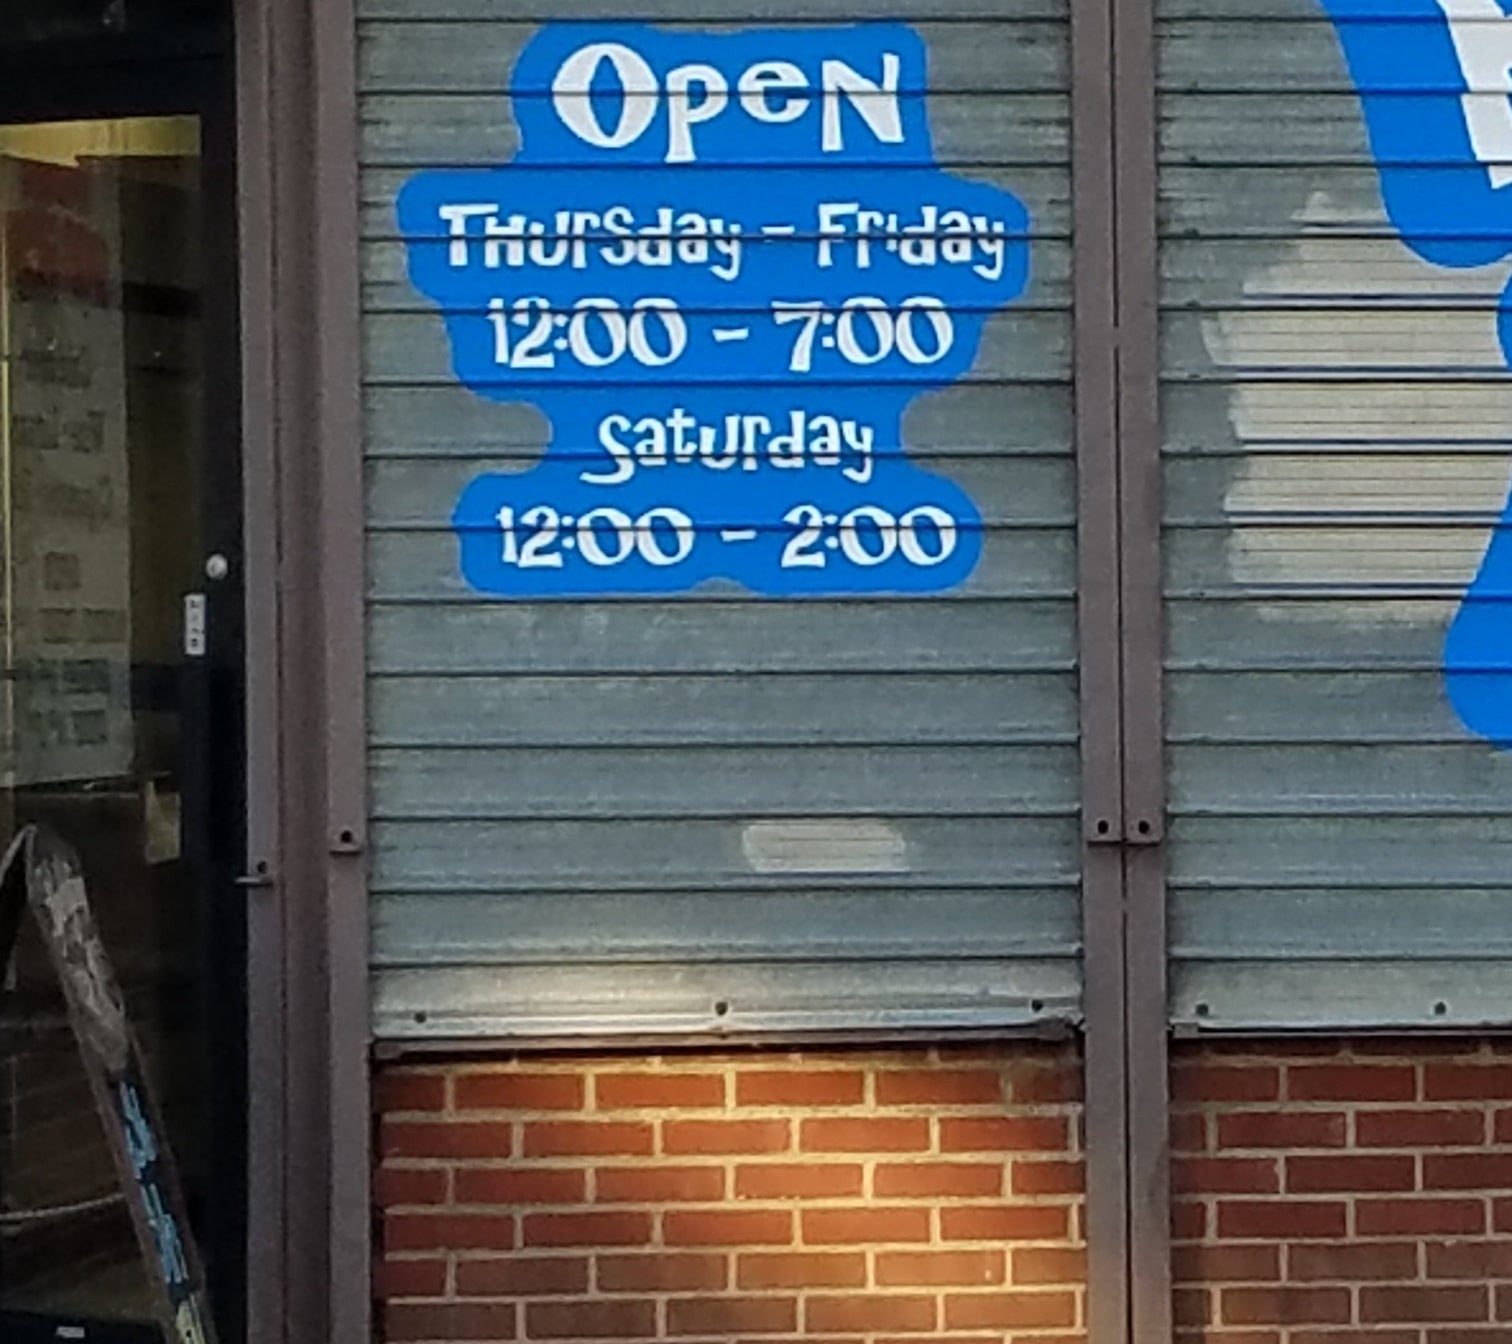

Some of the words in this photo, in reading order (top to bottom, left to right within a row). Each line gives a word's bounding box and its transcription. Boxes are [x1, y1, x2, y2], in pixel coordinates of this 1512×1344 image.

[487, 297, 687, 368] 12:00
[771, 296, 954, 372] 7:00
[579, 407, 874, 484] Saturday
[496, 505, 695, 568] 12:00
[780, 504, 957, 568] 2:00
